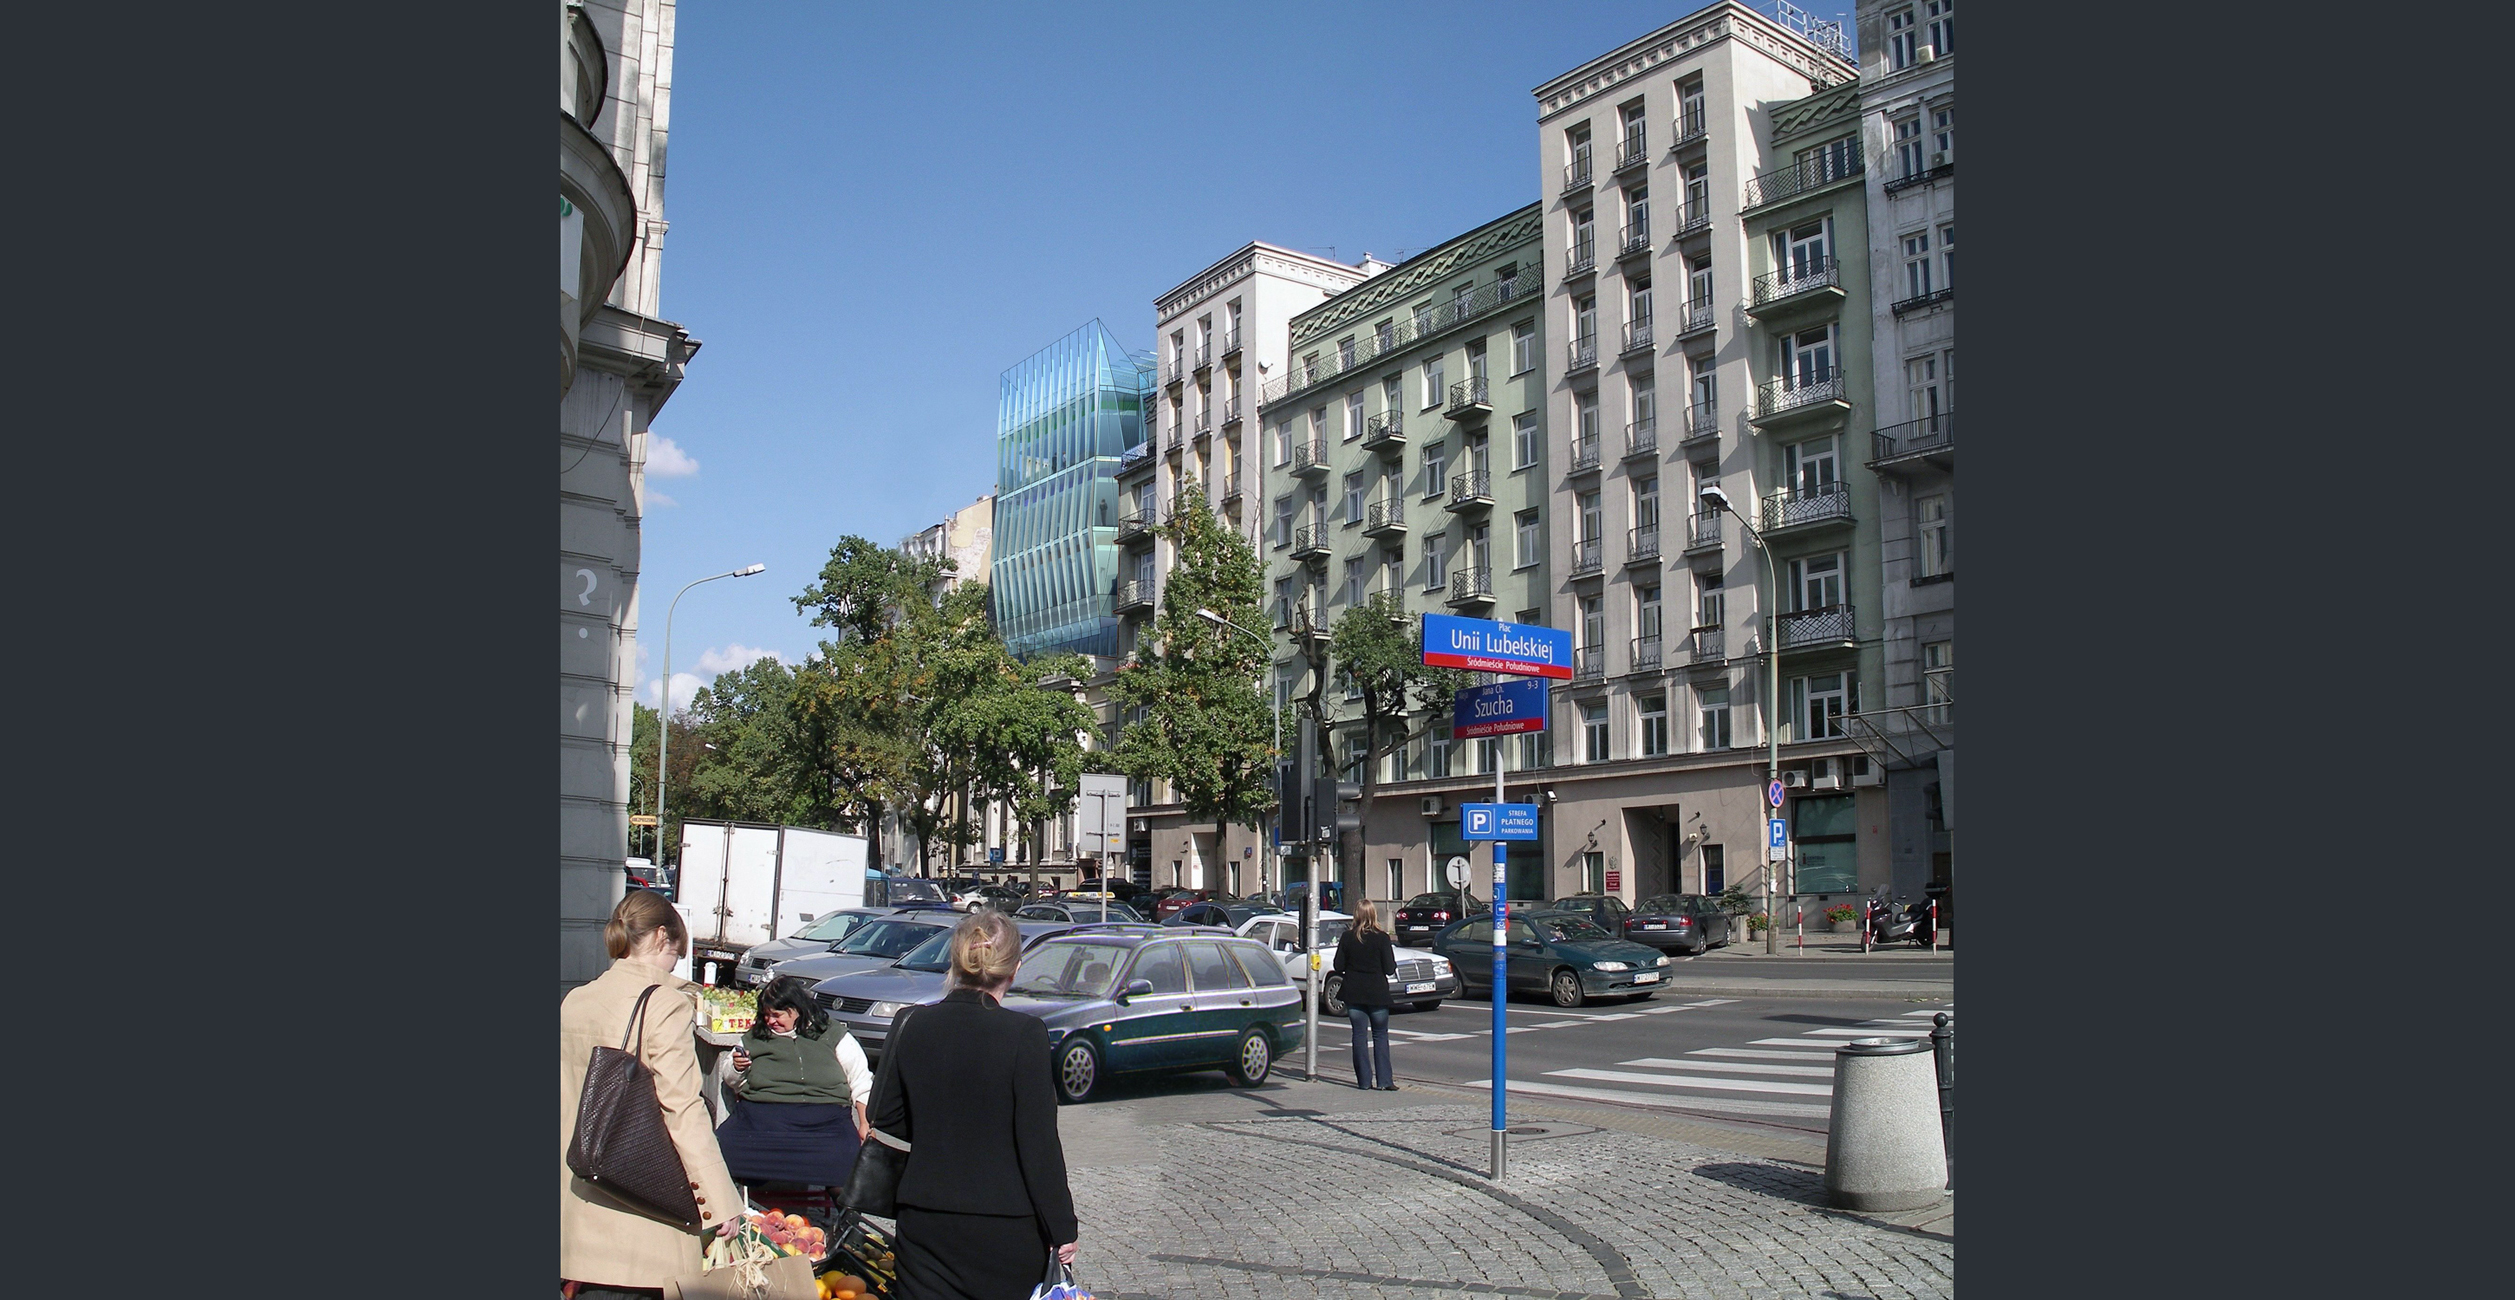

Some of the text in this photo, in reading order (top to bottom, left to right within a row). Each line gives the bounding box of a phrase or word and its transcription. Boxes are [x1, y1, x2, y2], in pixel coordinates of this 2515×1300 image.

[1498, 622, 1512, 633] Plac
[1451, 628, 1553, 664] Unii Lubelskiej
[1466, 655, 1541, 673] Śródmieście Południowe
[1482, 684, 1505, 696] Jana Ch.
[1527, 679, 1539, 690] 9-3
[1474, 694, 1514, 718] Szucha
[1493, 721, 1525, 732] Południowe
[1473, 813, 1487, 831] P
[1501, 818, 1534, 826] PŁATNEGO
[1773, 822, 1783, 844] P
